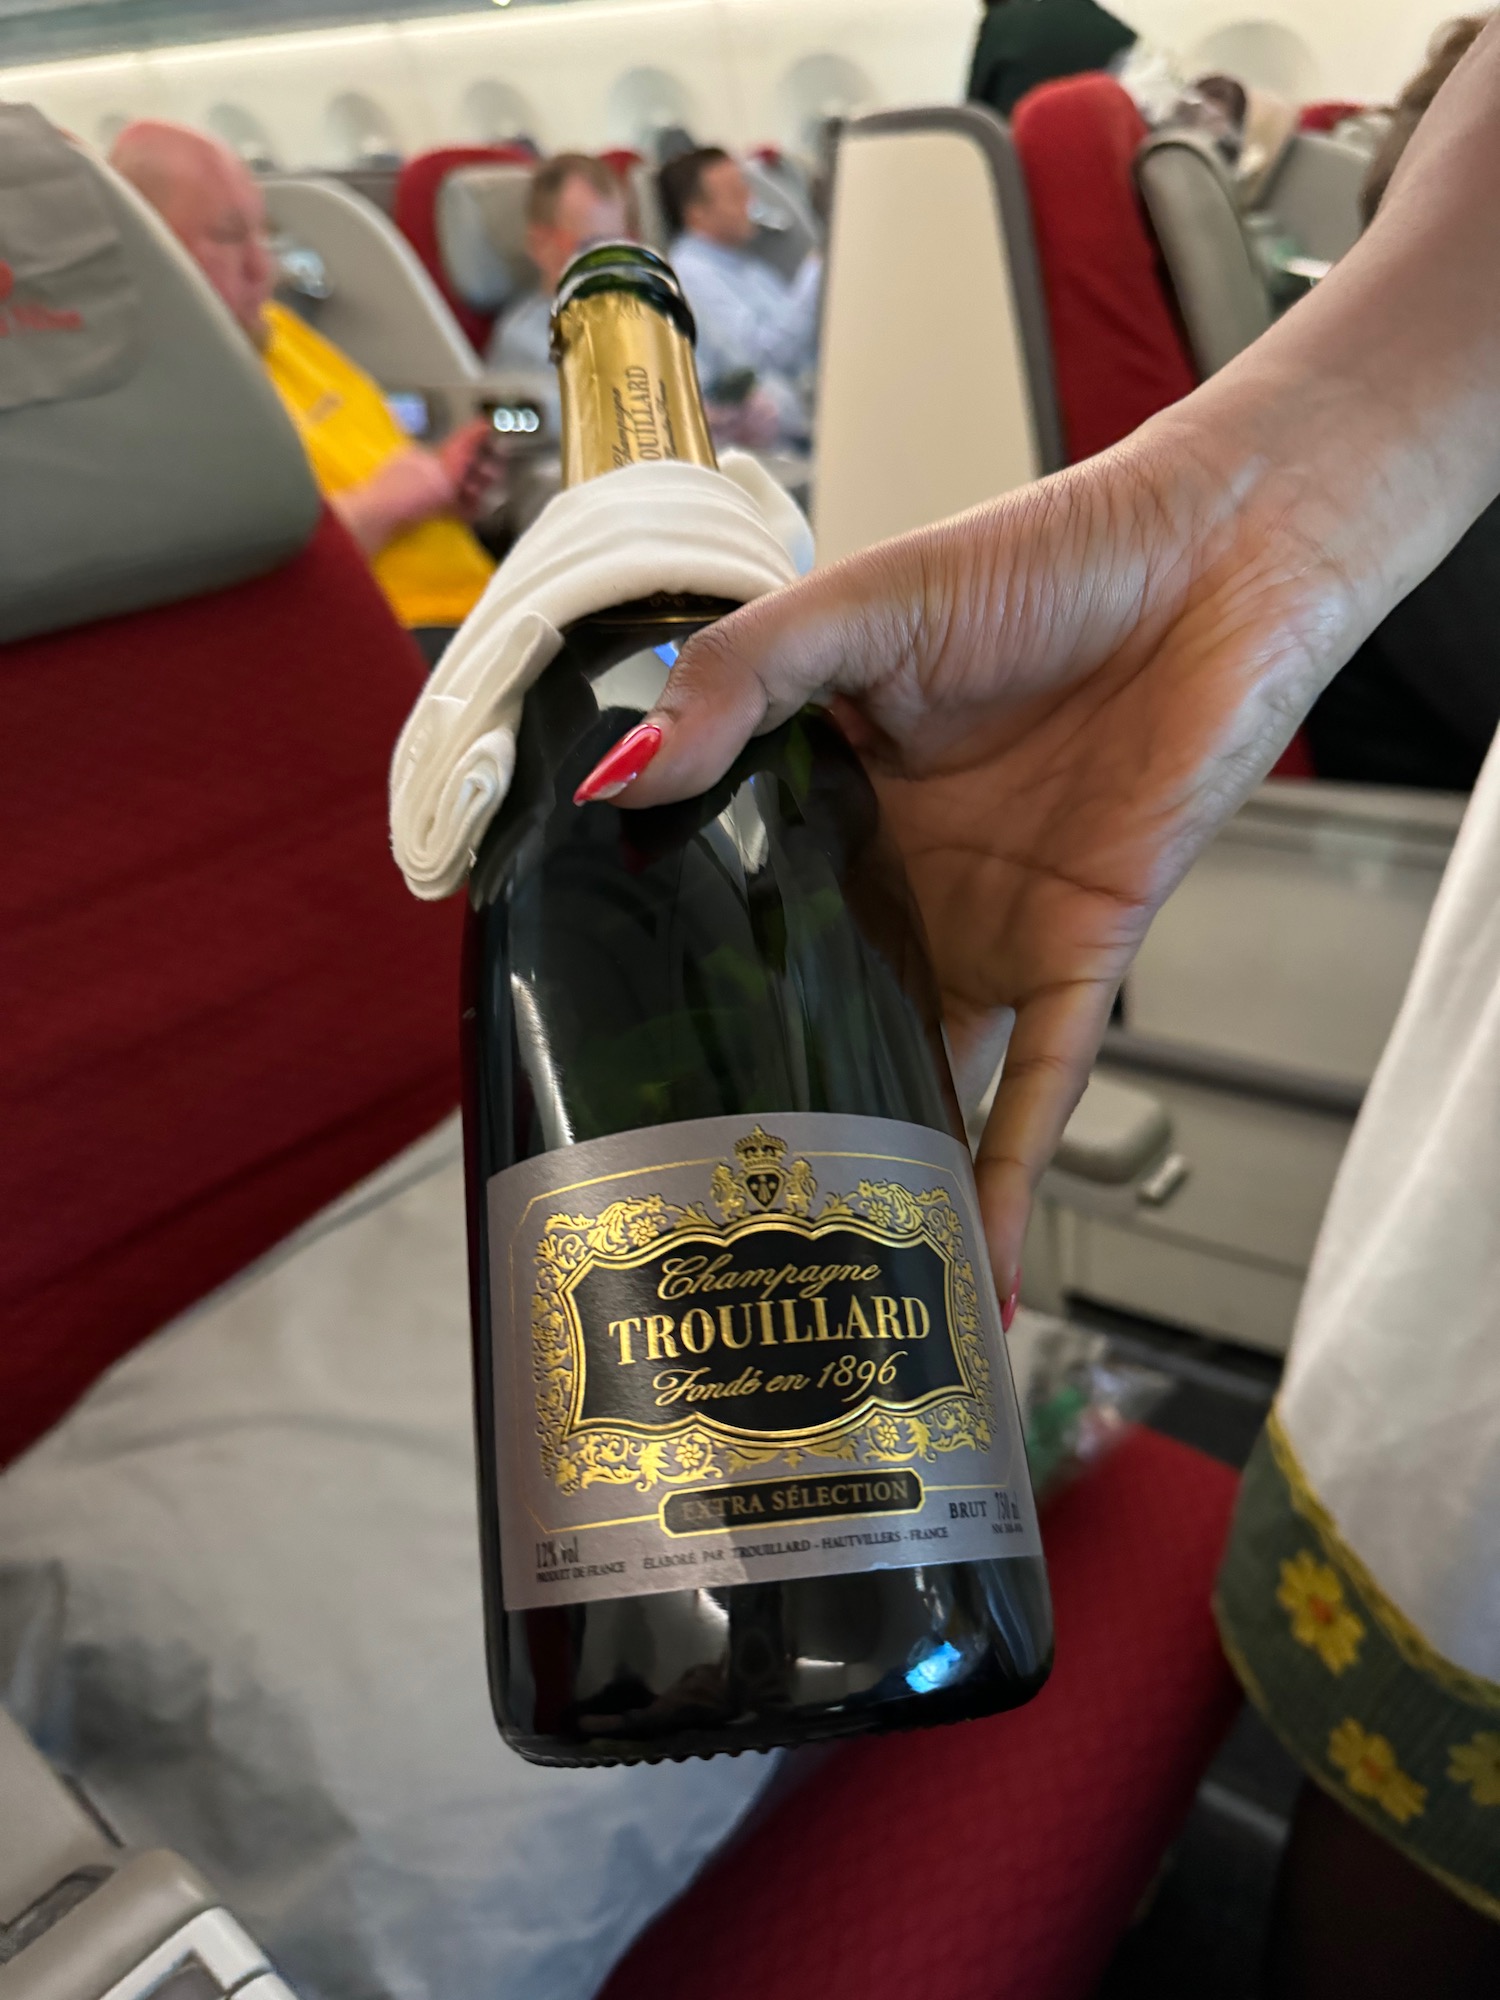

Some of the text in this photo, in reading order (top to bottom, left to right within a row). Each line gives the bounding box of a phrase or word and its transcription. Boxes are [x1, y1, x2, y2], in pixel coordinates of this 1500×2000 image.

[625, 366, 661, 460] OUILLARD
[657, 1253, 881, 1300] Champagne
[608, 1295, 931, 1366] TROUILLARD
[652, 1350, 908, 1406] Fondé en 1896
[682, 1479, 909, 1522] EXTRA SÉLECTION
[949, 1501, 987, 1519] BRUT
[702, 1549, 726, 1563] PAR
[733, 1539, 811, 1559] TROUILLARD
[822, 1531, 901, 1549] HAUTVILLERS
[910, 1527, 949, 1542] FRANCE
[586, 1561, 627, 1577] FRANCE
